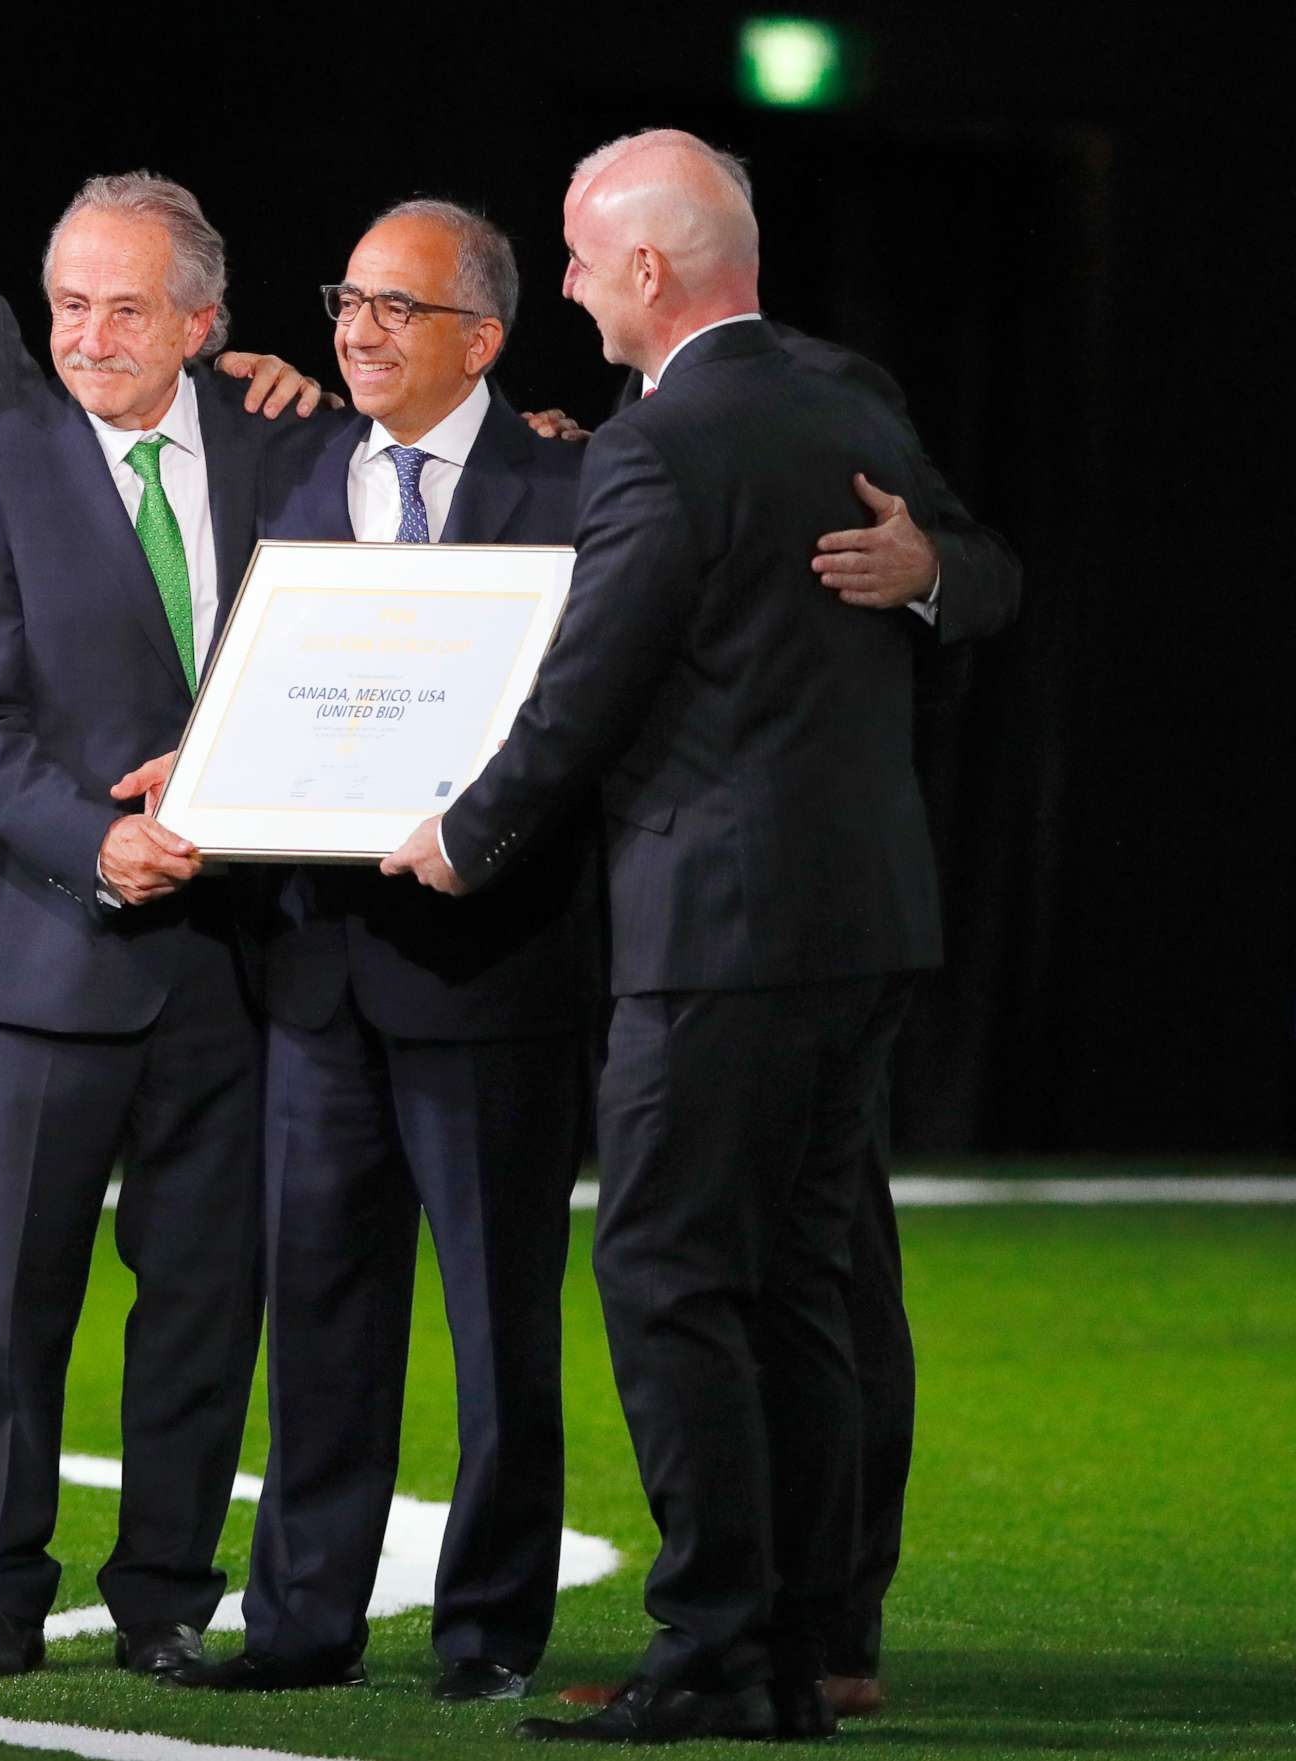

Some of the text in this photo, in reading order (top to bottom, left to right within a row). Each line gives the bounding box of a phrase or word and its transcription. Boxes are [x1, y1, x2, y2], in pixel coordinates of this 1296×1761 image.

[288, 686, 446, 703] CANADA, MEXICO, USA
[316, 704, 405, 720] (UNITED BID)
